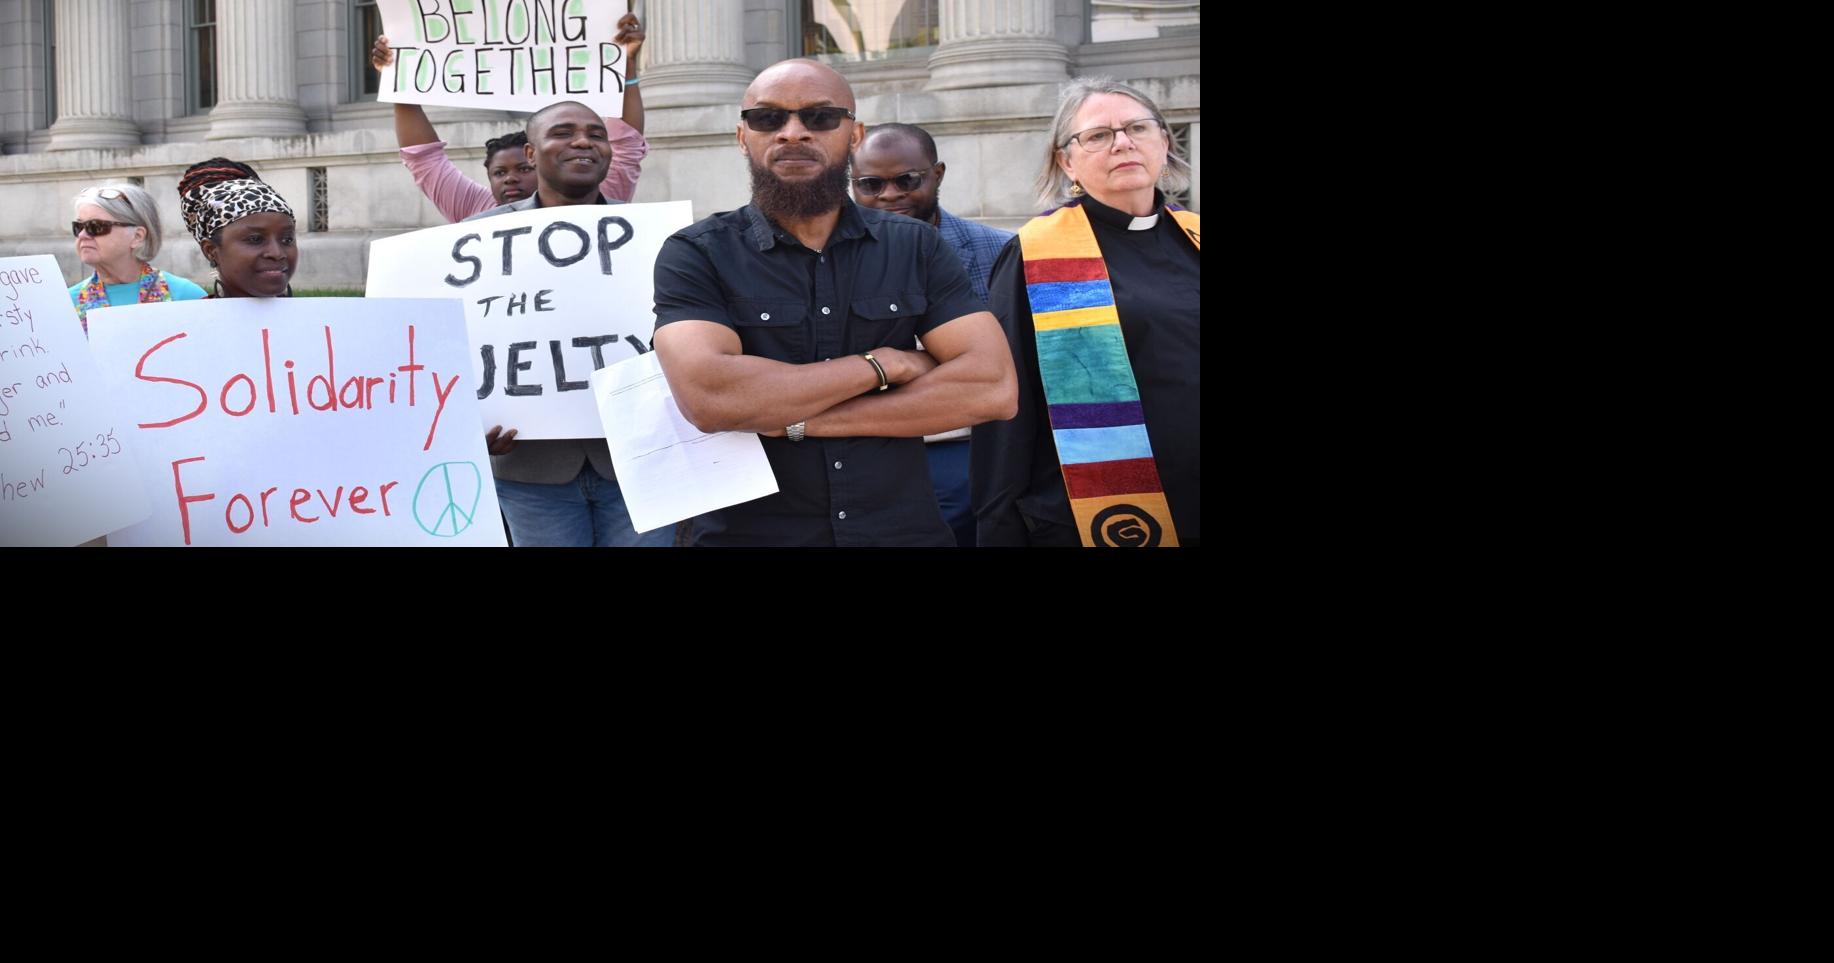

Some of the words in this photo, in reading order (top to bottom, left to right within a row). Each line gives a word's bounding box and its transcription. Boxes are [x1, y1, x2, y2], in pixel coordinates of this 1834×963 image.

[416, 0, 588, 45] BELONG
[389, 42, 624, 96] TOGETHER
[444, 215, 634, 288] STOP
[0, 267, 43, 301] gave
[477, 289, 556, 317] THE
[0, 303, 34, 333] sty
[36, 362, 72, 389] and
[135, 325, 460, 451] Solidarity
[0, 468, 44, 501] hew
[57, 427, 121, 475] 25:35
[171, 456, 399, 545] Forever
